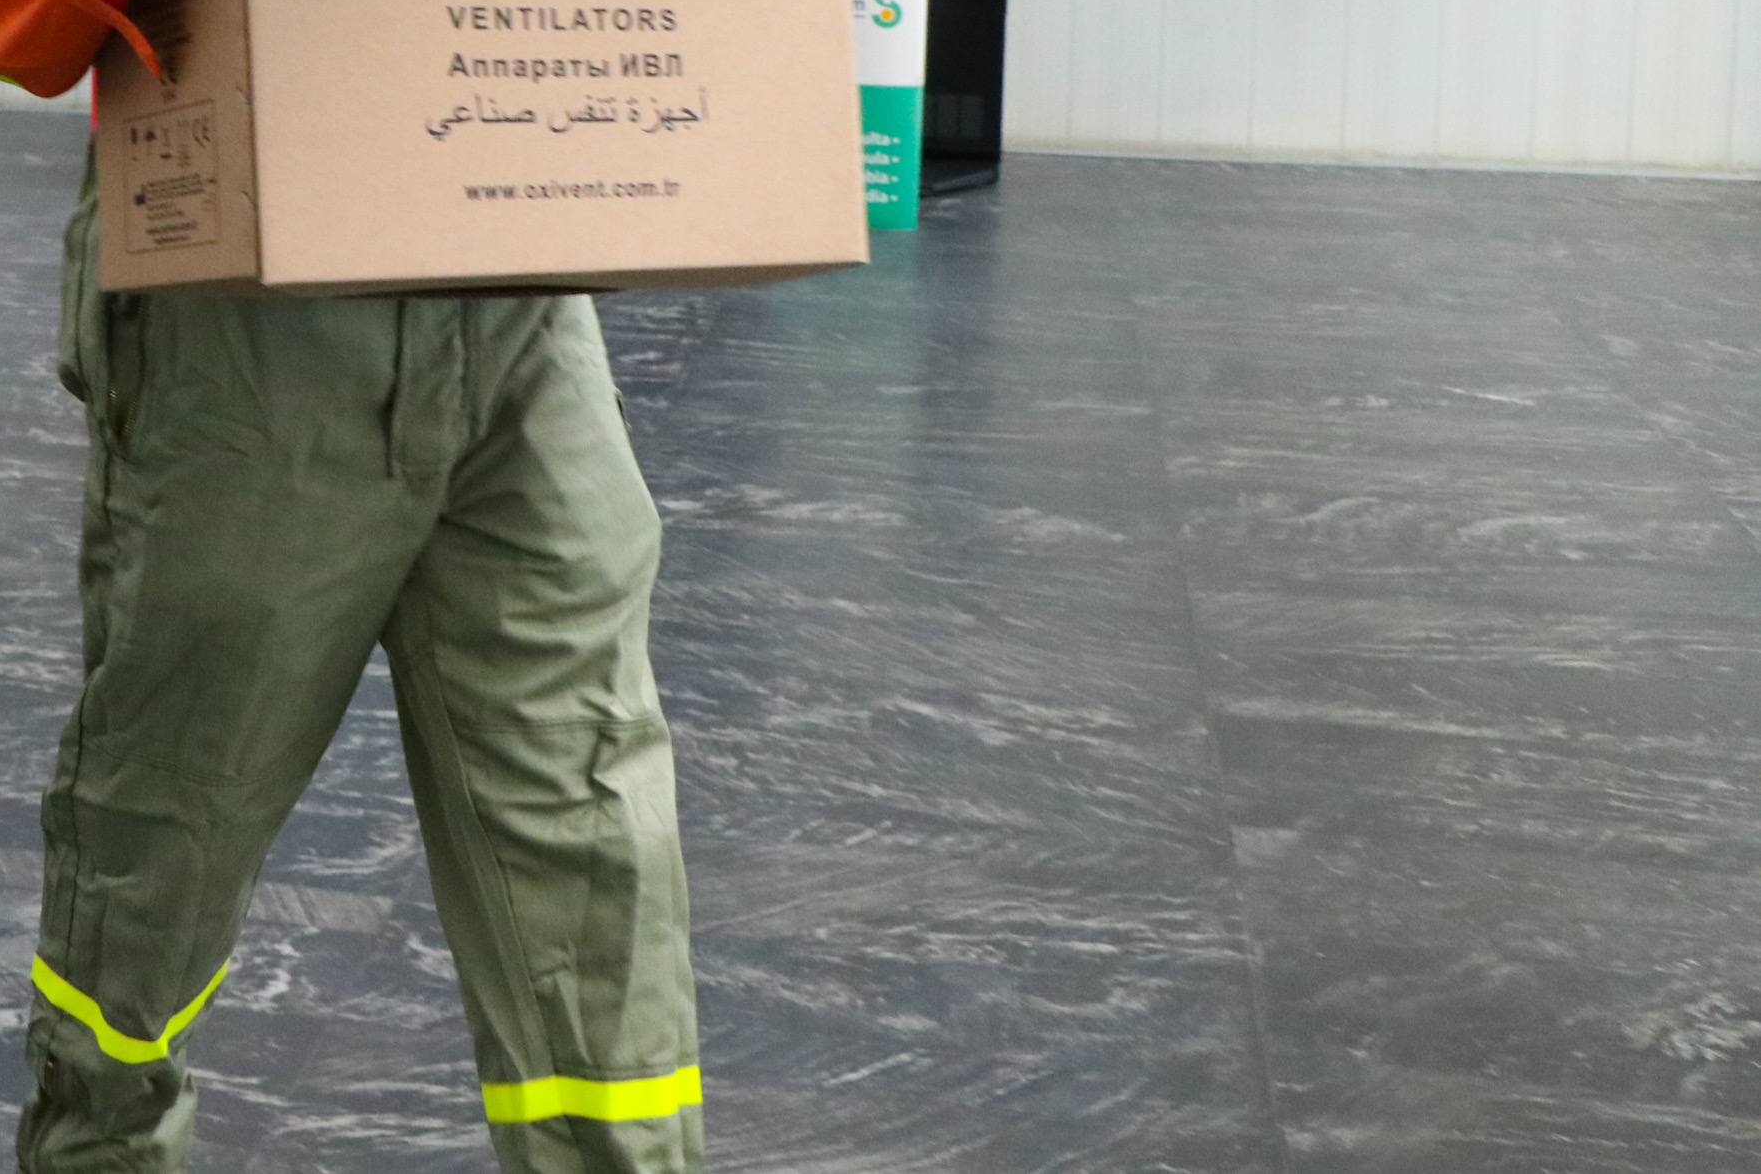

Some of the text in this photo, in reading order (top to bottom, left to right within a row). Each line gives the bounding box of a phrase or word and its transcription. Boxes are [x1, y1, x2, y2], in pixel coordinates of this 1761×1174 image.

[447, 6, 677, 32] VENTILATORS
[448, 52, 682, 82] Аппараты ИВЛ
[425, 92, 537, 142] صناعي
[625, 85, 707, 134] أجهزة
[464, 180, 681, 201] www.oxivent.com.tr
